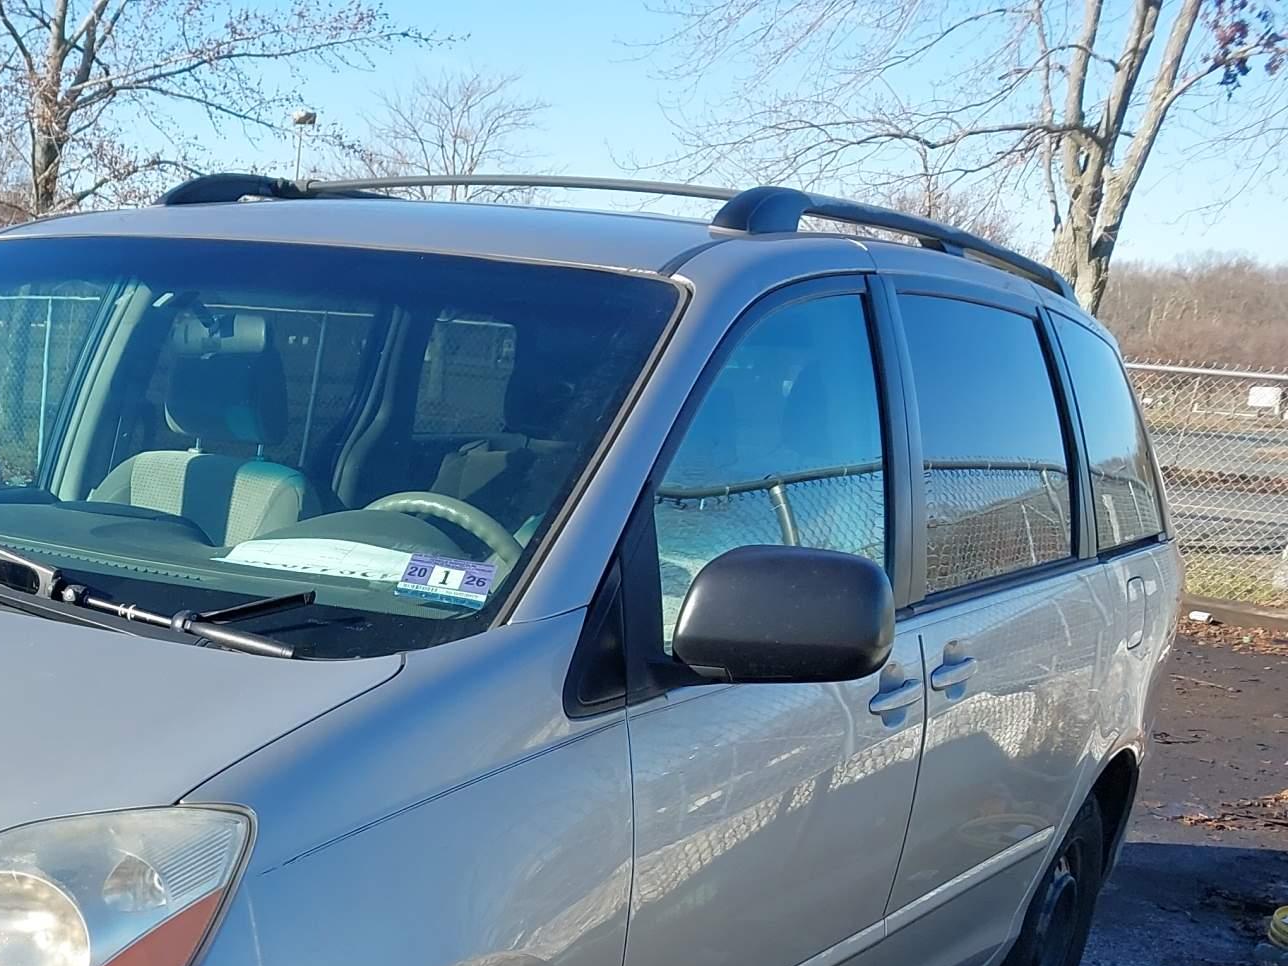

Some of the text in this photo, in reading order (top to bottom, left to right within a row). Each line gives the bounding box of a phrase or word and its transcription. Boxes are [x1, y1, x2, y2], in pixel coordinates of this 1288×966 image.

[407, 566, 427, 577] 20
[438, 570, 450, 585] 1
[464, 575, 487, 587] 26
